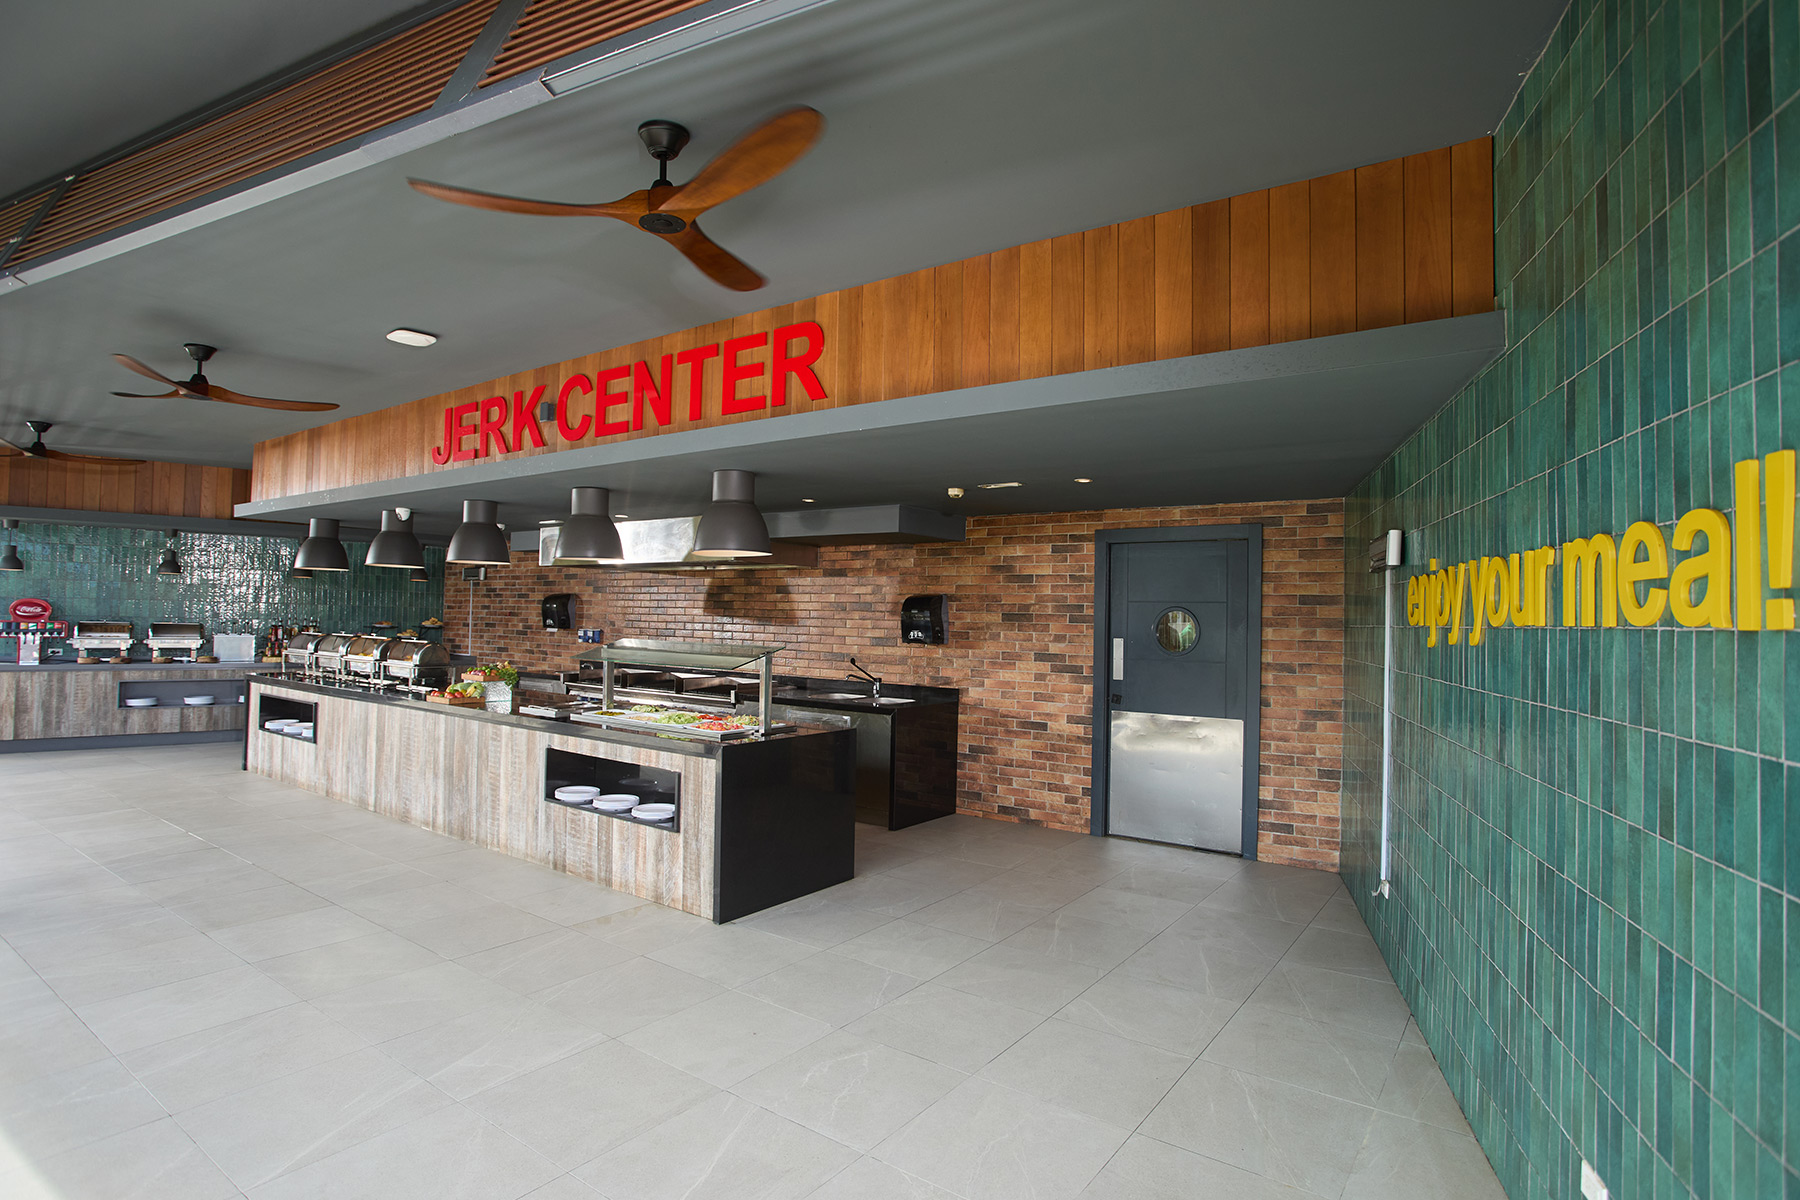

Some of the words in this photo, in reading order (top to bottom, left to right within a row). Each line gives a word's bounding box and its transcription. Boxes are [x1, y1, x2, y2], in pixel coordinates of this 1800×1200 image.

[431, 384, 546, 466] JERK
[556, 321, 828, 442] CENTER
[1407, 558, 1466, 648] enjoy
[1469, 545, 1555, 647] your
[1562, 449, 1796, 631] meal!
